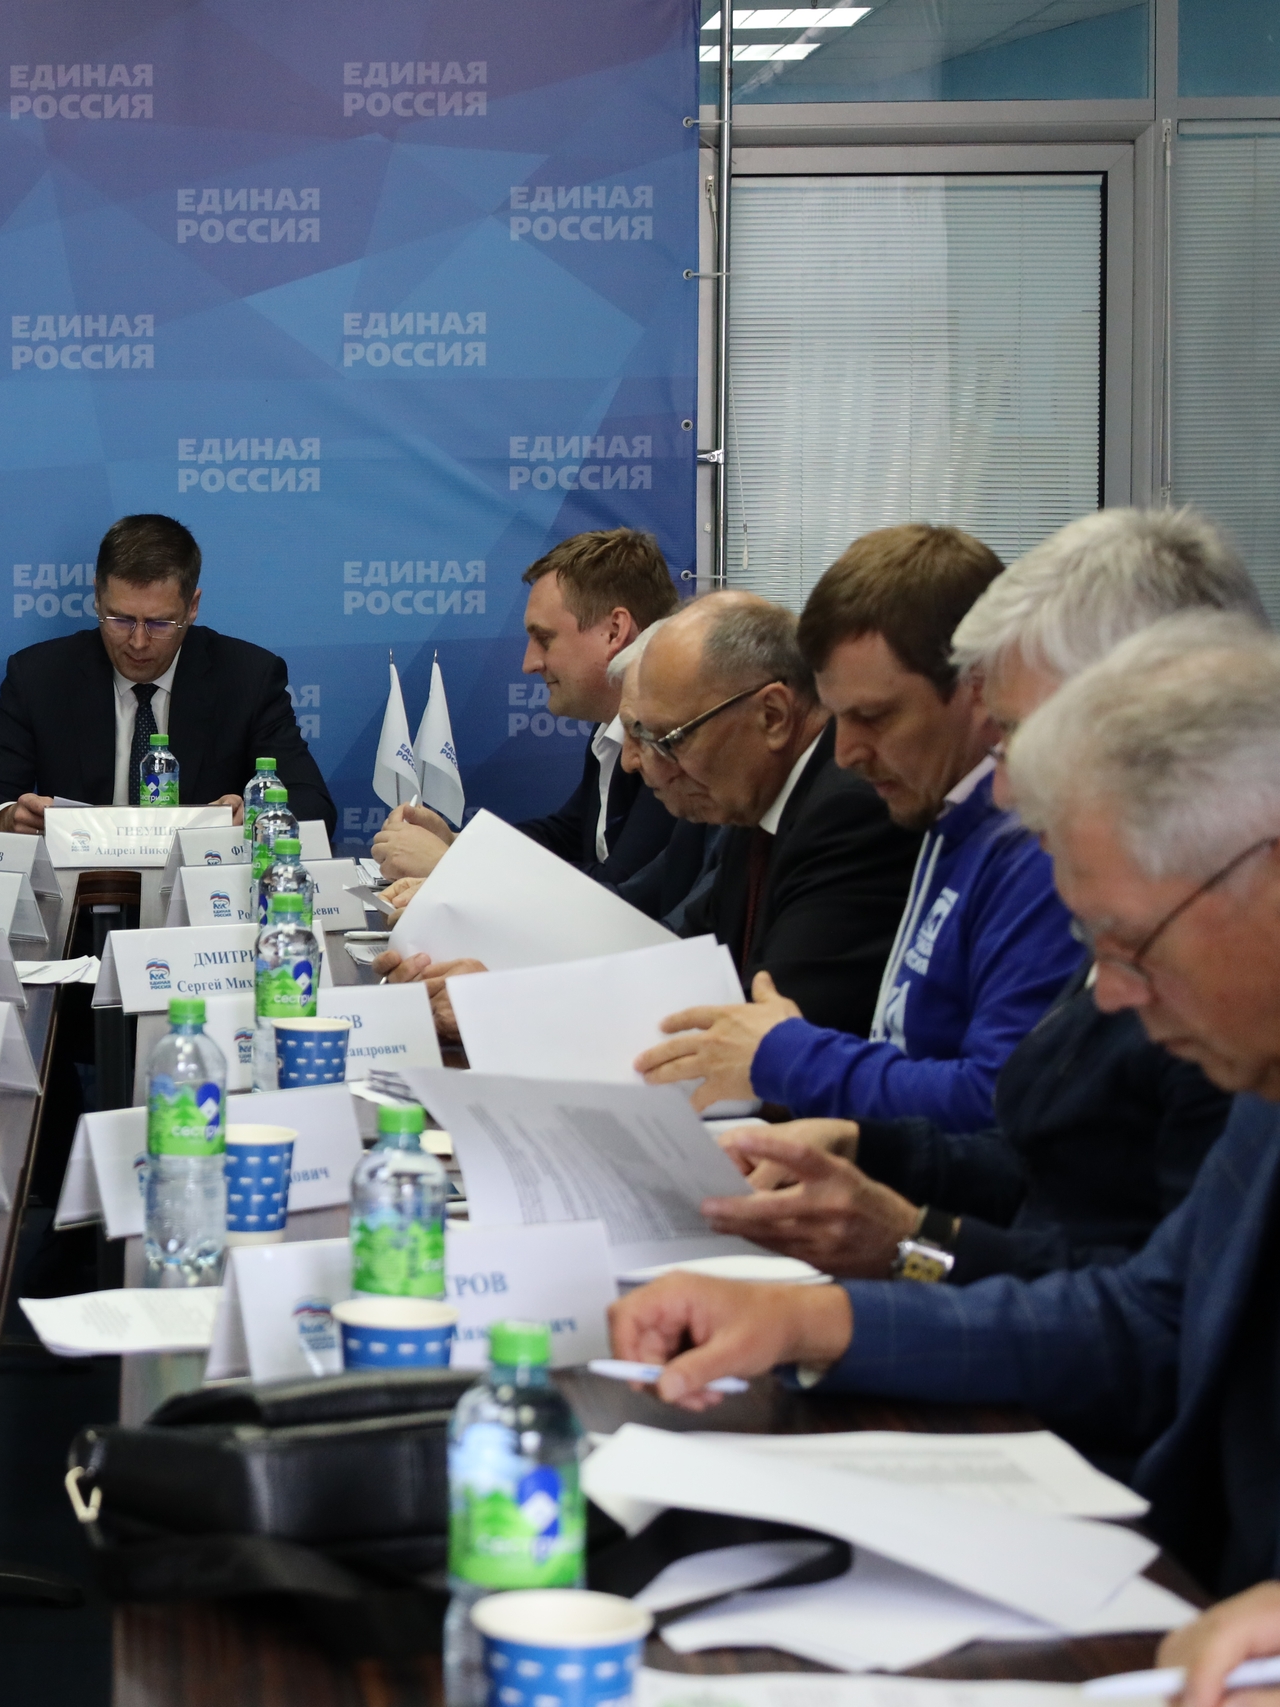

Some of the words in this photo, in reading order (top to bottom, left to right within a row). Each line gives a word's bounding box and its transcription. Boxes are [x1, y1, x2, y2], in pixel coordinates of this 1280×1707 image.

[10, 63, 154, 91] ЕДИНАЯ
[343, 61, 487, 88] ЕДИНАЯ
[10, 94, 154, 120] РОССИЯ
[343, 91, 487, 117] РОССИЯ
[177, 188, 320, 215] ЕДИНАЯ
[510, 185, 653, 212] ЕДИНАЯ
[177, 217, 320, 243] РОССИЯ
[510, 215, 653, 241] РОССИЯ
[11, 314, 154, 341] ЕДИНАЯ
[343, 312, 486, 338] ЕДИНАЯ
[11, 344, 154, 370] РОССИЯ
[343, 341, 486, 367] РОССИЯ
[177, 438, 320, 464] ЕДИНАЯ
[509, 435, 652, 462] ЕДИНАЯ
[177, 467, 320, 493] РОССИЯ
[509, 464, 652, 491] РОССИЯ
[343, 560, 486, 587] ЕДИНАЯ
[13, 592, 98, 618] РОСС
[343, 590, 486, 615] РОССИЯ
[177, 978, 223, 995] Сергей
[348, 1044, 408, 1059] андрович
